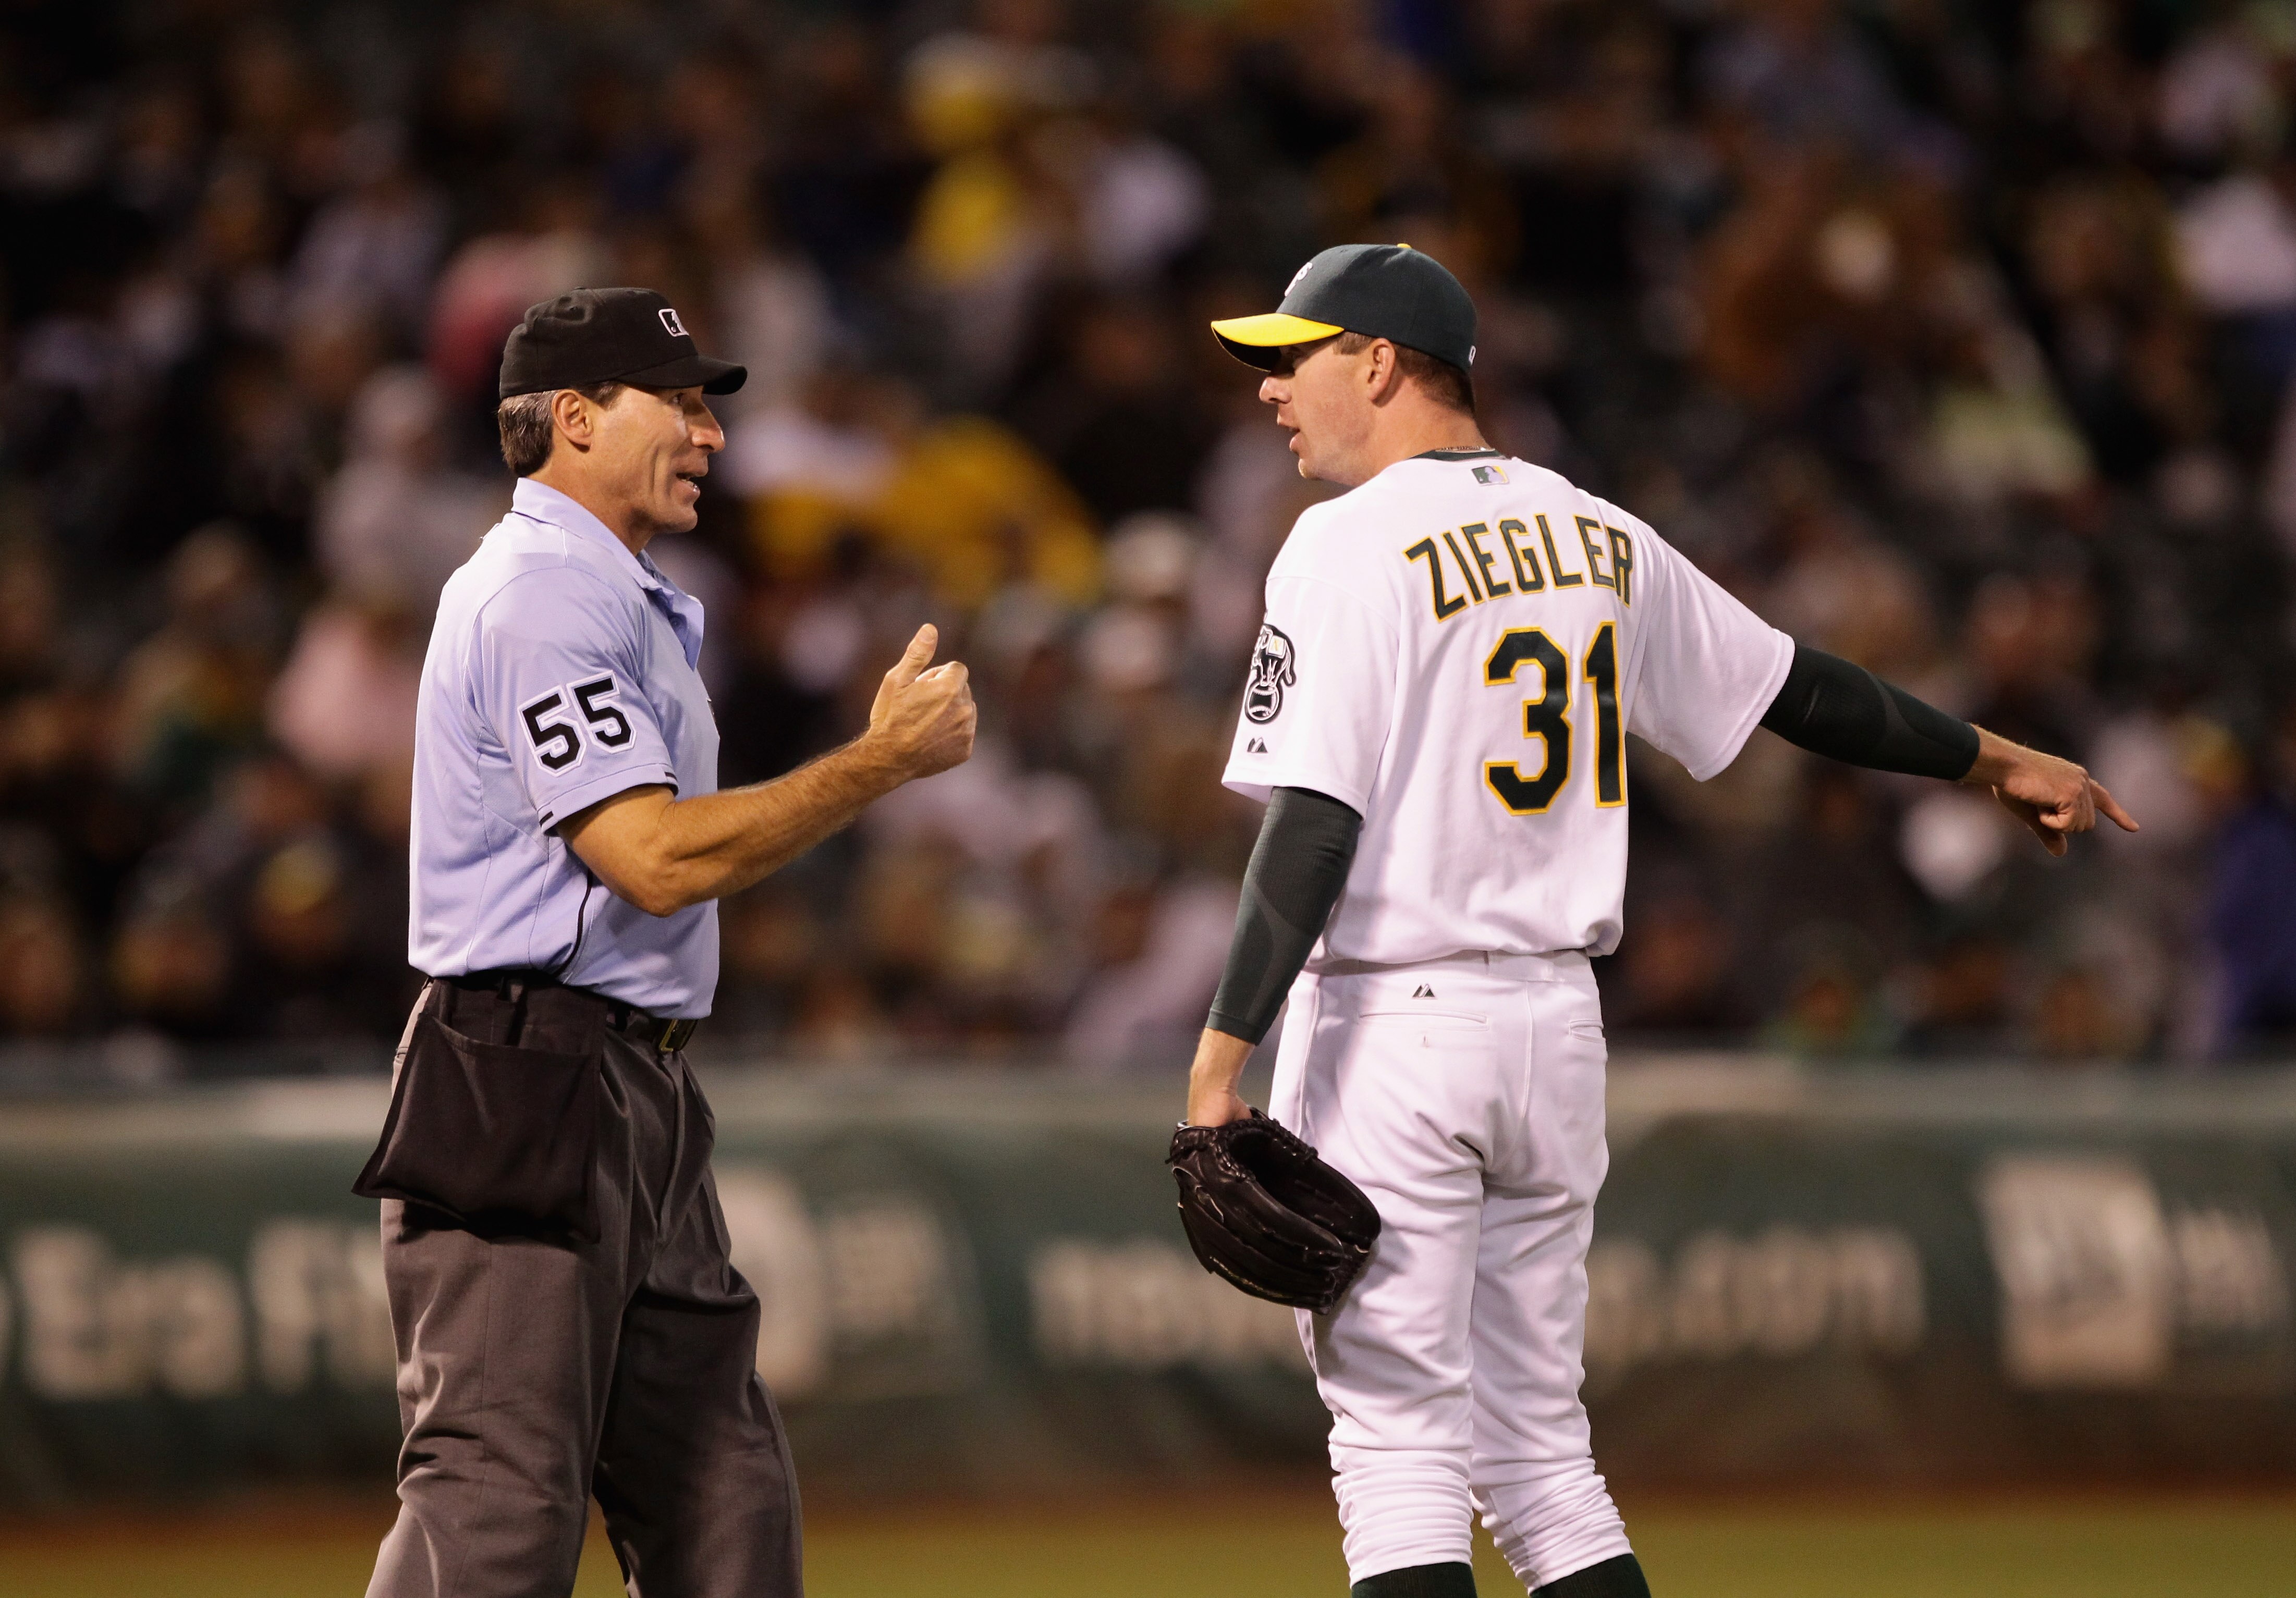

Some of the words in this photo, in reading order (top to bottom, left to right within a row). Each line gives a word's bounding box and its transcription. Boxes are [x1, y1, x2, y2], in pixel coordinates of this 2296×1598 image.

[1402, 513, 1634, 622] ZIEGLER
[518, 671, 637, 777] 55
[1484, 621, 1627, 817] 31
